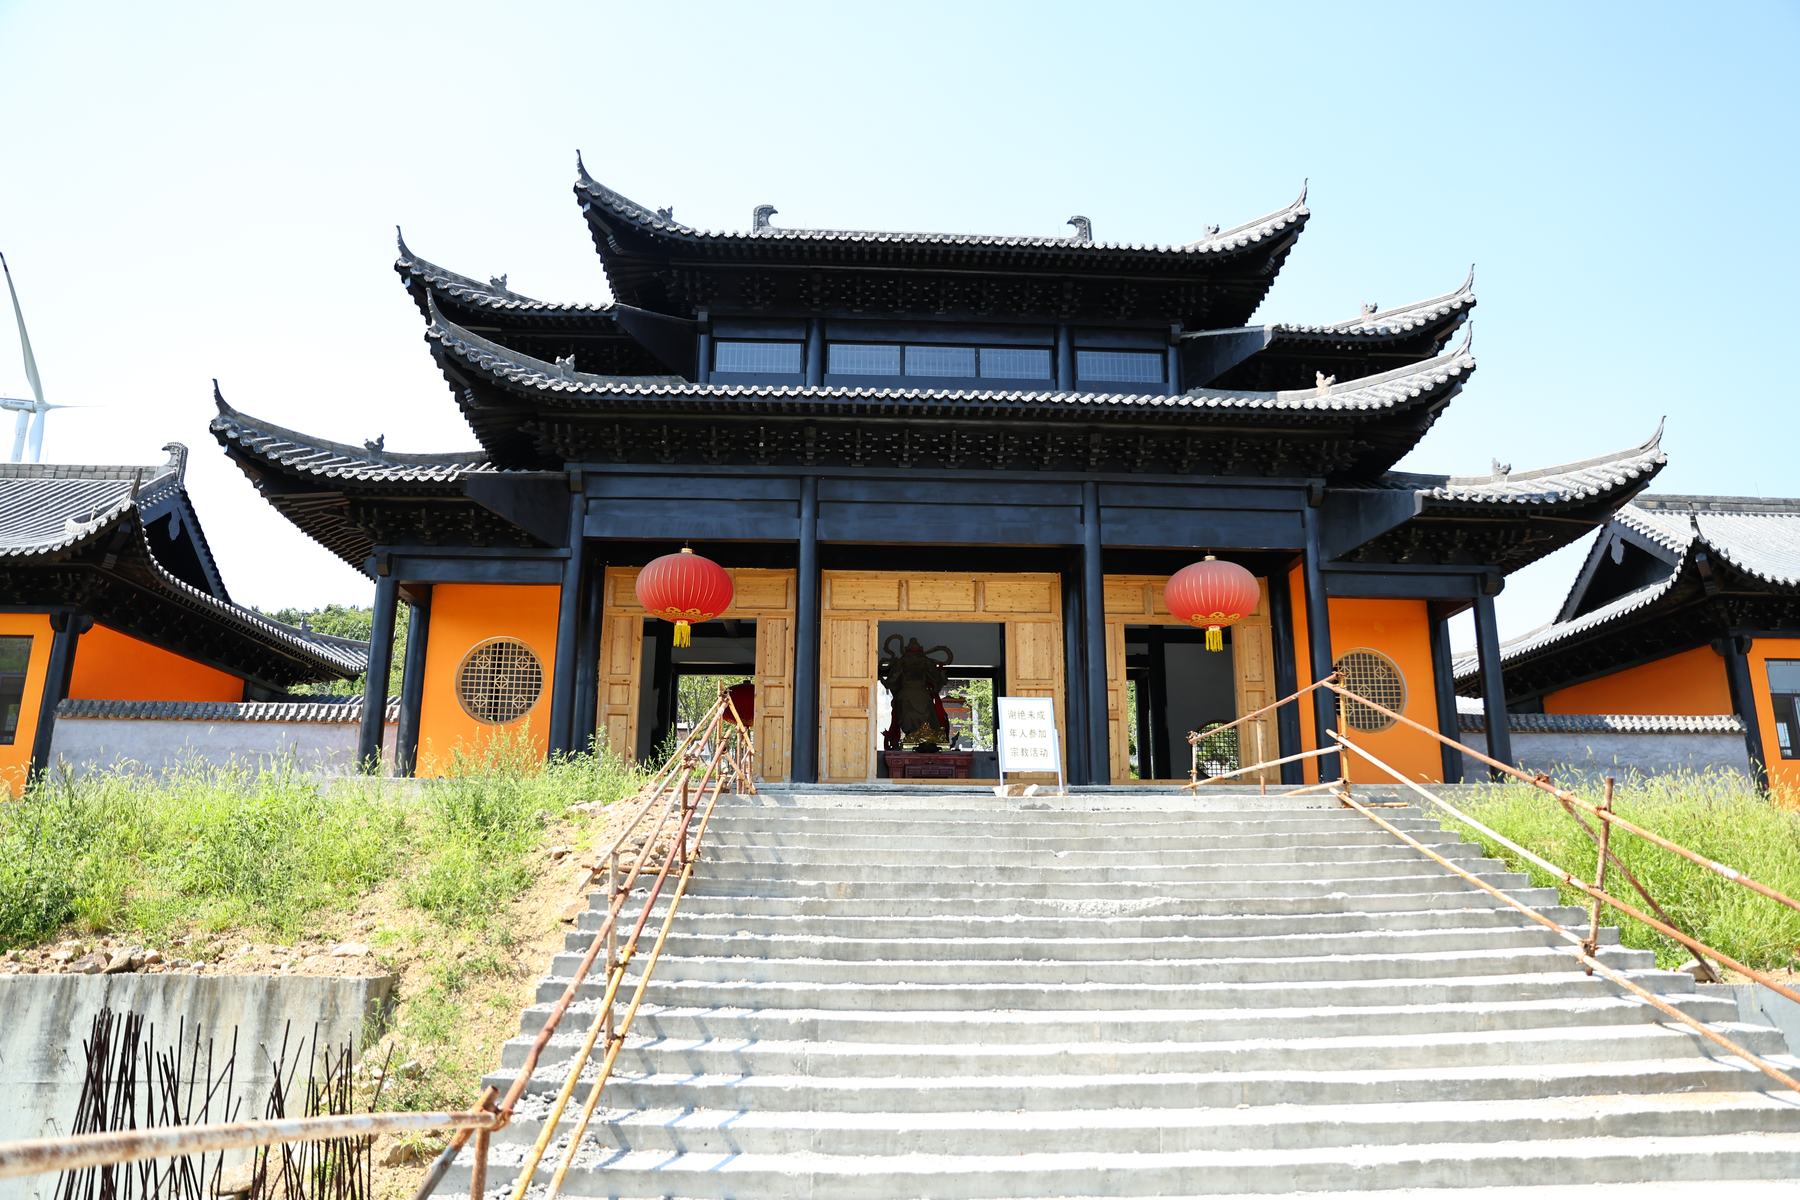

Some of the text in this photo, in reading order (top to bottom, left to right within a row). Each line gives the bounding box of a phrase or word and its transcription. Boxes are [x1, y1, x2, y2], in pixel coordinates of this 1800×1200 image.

[1008, 710, 1045, 720] 谢绝未成
[1009, 728, 1047, 739] 年人参加
[1010, 747, 1049, 758] 宗教活动
